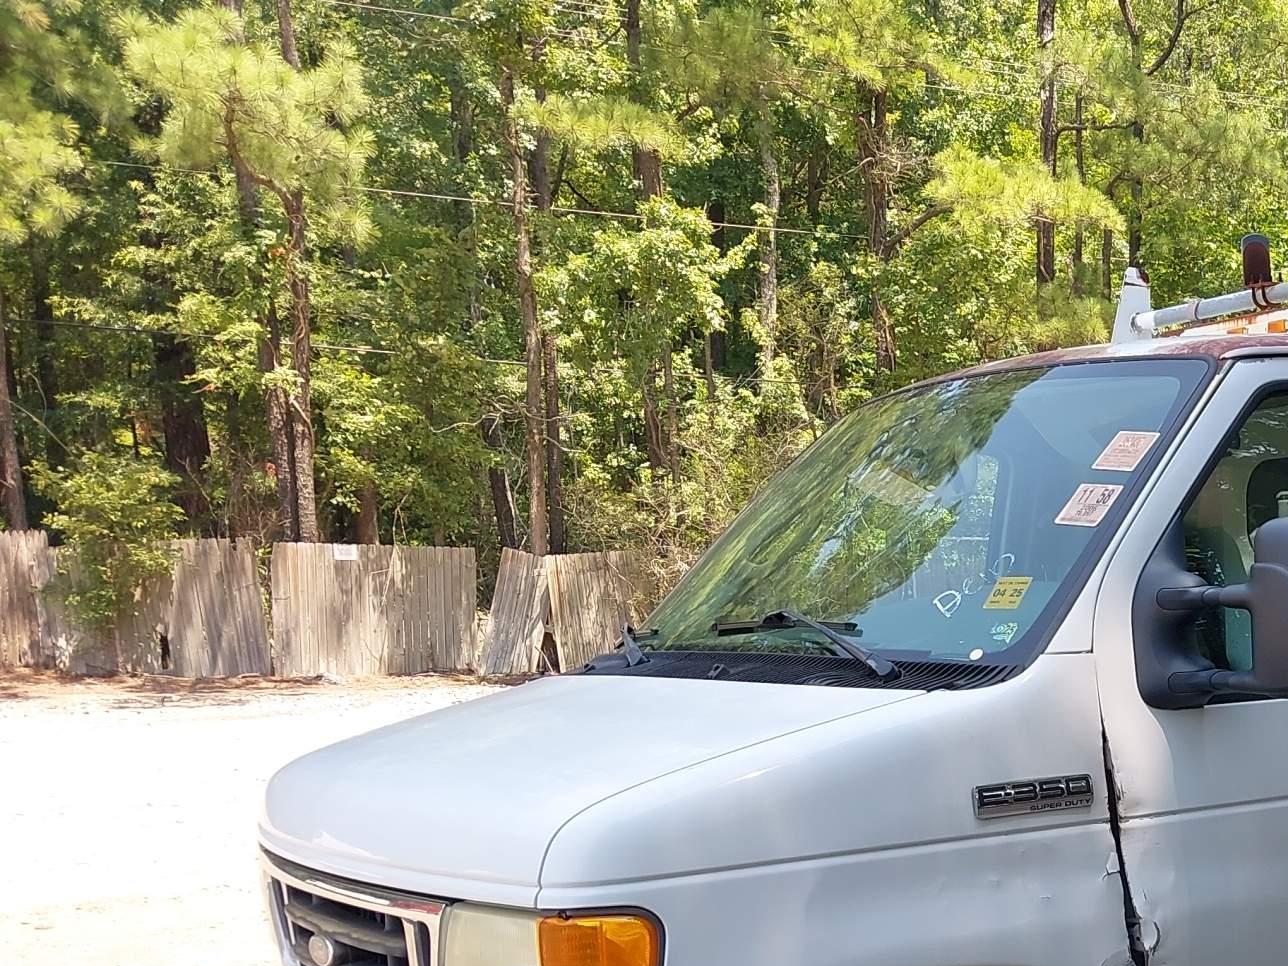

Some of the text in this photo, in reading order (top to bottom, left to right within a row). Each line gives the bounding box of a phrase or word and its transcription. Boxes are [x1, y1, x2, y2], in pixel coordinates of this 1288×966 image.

[1079, 488, 1115, 504] 11 58
[1009, 588, 1024, 598] 25
[1030, 799, 1091, 811] SUPER DUTY
